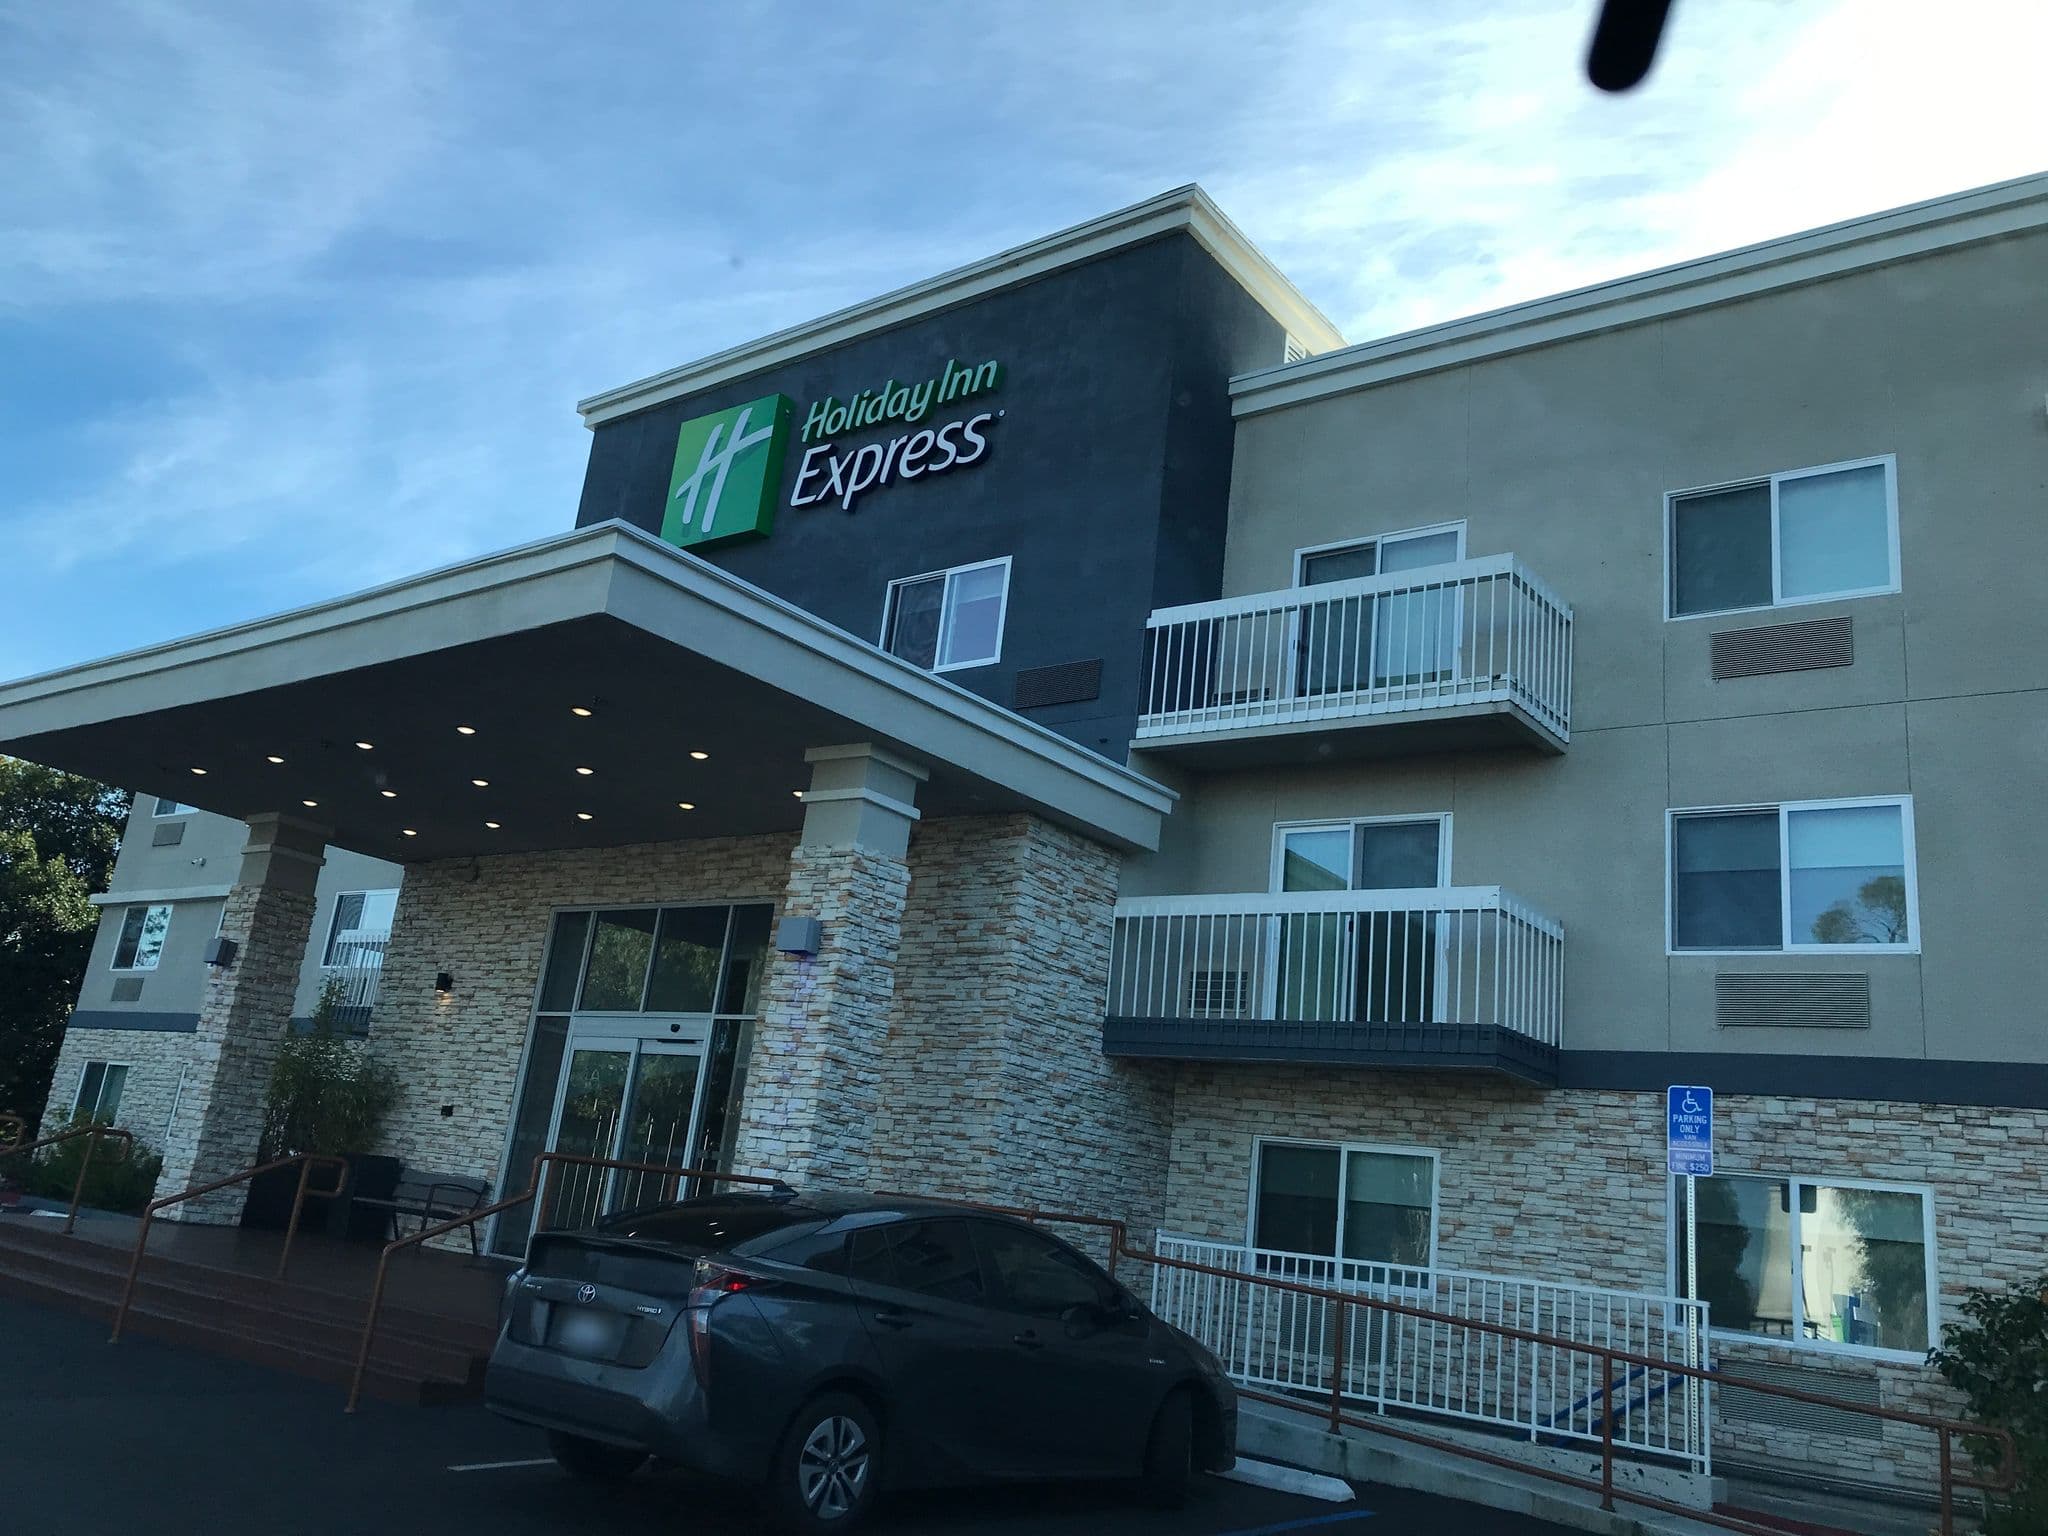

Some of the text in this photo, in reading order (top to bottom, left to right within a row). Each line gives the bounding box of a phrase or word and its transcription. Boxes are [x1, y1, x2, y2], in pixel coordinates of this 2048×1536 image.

[801, 359, 998, 442] Holiday Inn
[790, 413, 991, 511] Express
[1672, 1114, 1707, 1125] PARKING
[1679, 1124, 1700, 1134] ONLY
[1675, 1152, 1706, 1163] MINIMUM
[1689, 1163, 1709, 1173] $250
